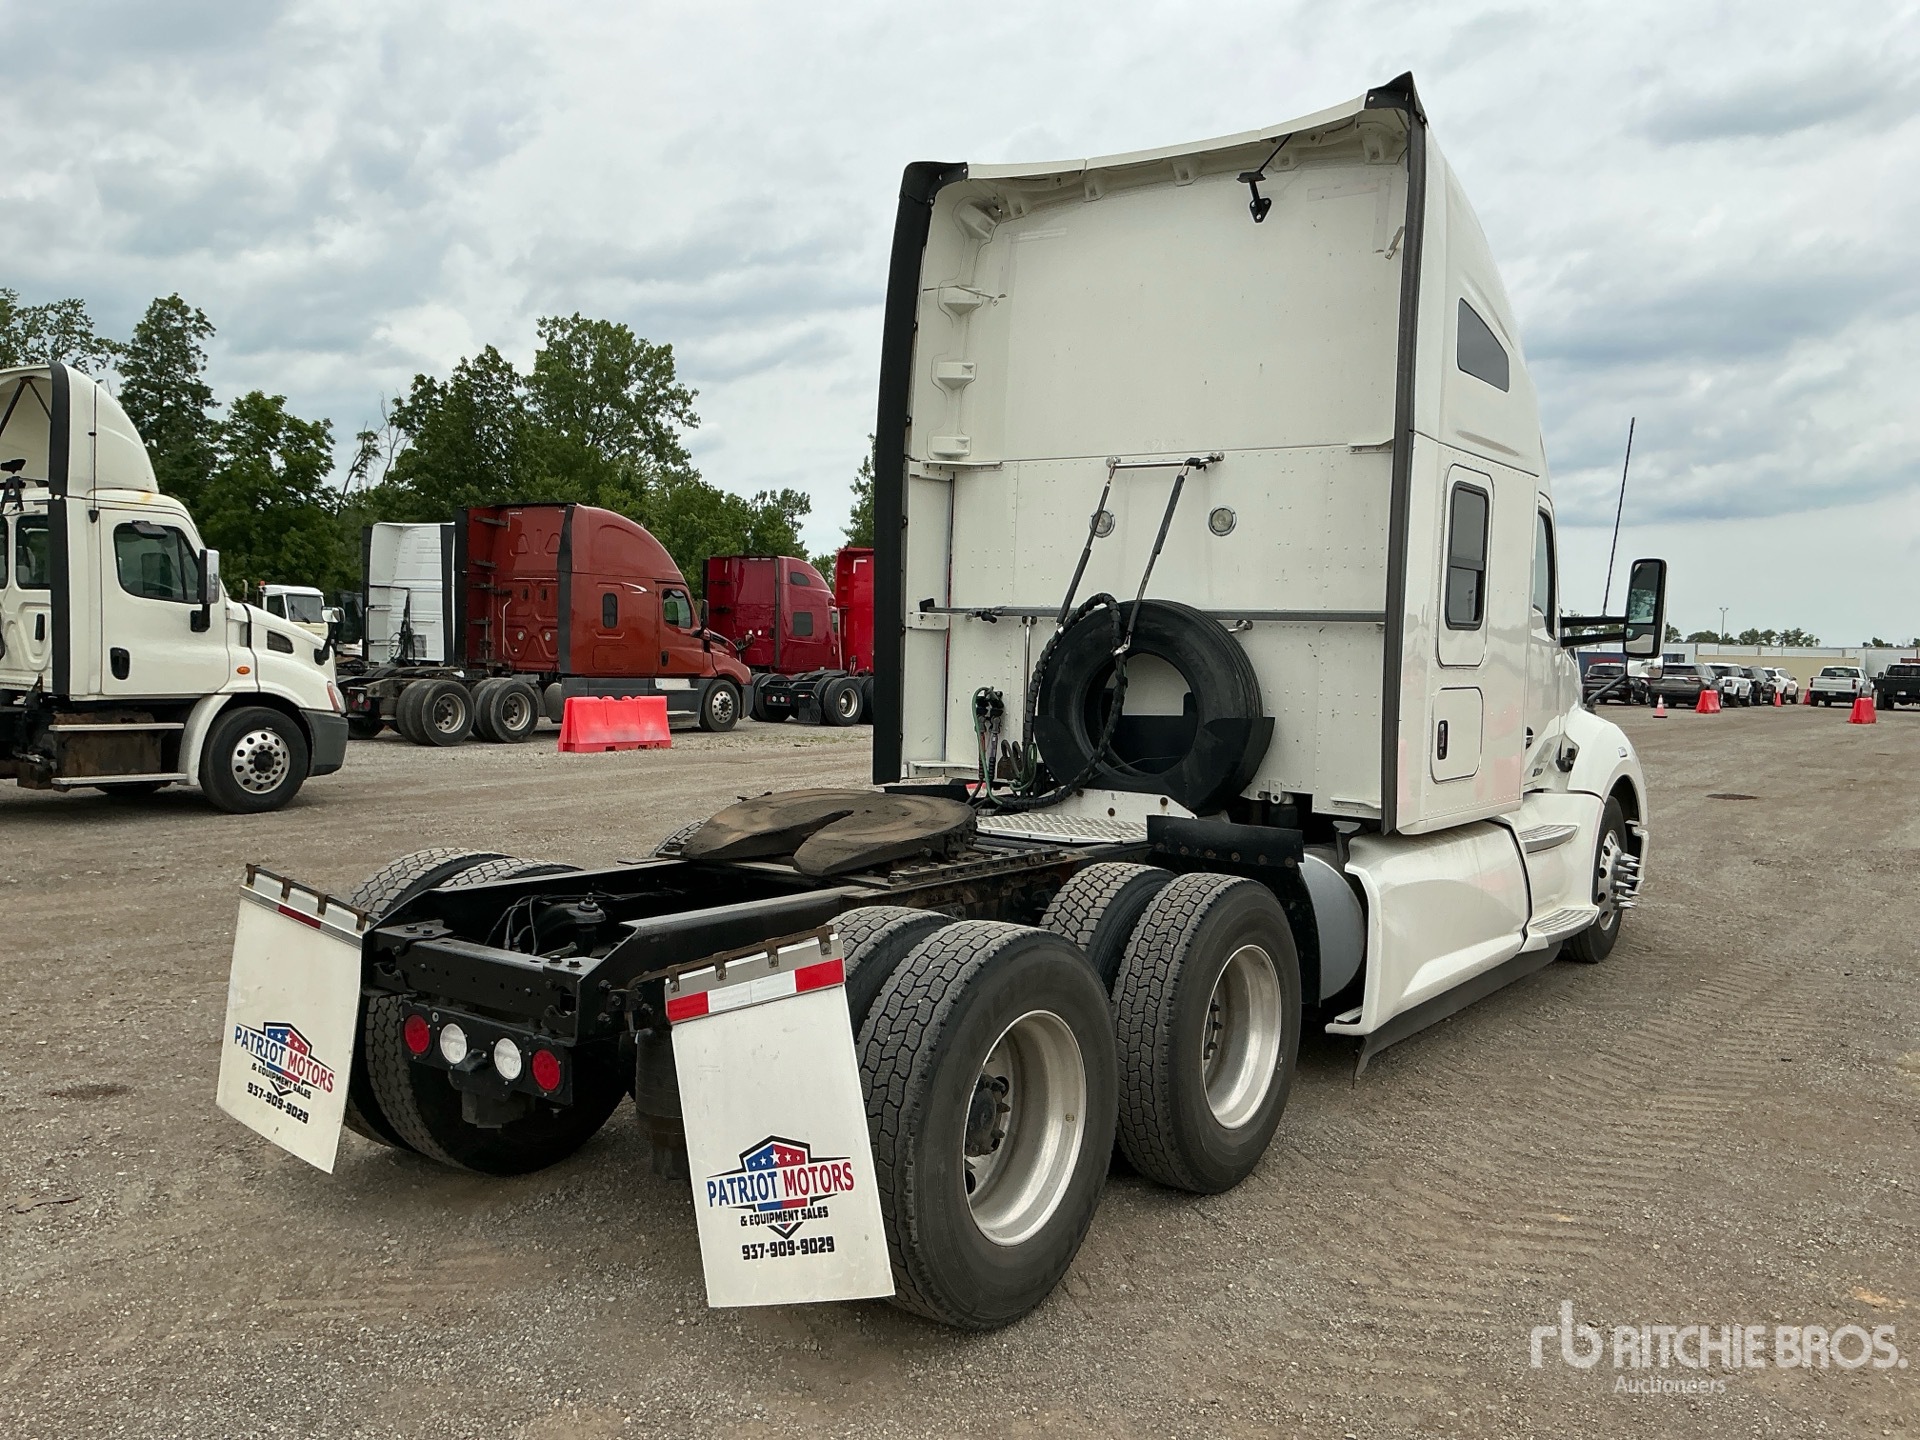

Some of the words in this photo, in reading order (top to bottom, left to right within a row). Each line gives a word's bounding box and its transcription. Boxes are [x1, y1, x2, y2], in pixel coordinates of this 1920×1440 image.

[234, 1025, 286, 1066] PATRIOT
[288, 1050, 335, 1093] MOTORS
[251, 1062, 257, 1071] &
[258, 1065, 292, 1089] EQUIPMENT
[292, 1083, 312, 1100] SALES
[247, 1082, 310, 1124] 937-909-9029
[707, 1171, 778, 1208] PATRIOT
[782, 1162, 854, 1197] MOTORS
[740, 1215, 747, 1227] &
[749, 1209, 799, 1226] EQUIPMENT
[801, 1206, 829, 1220] SALES
[742, 1236, 835, 1260] 937-909-9029
